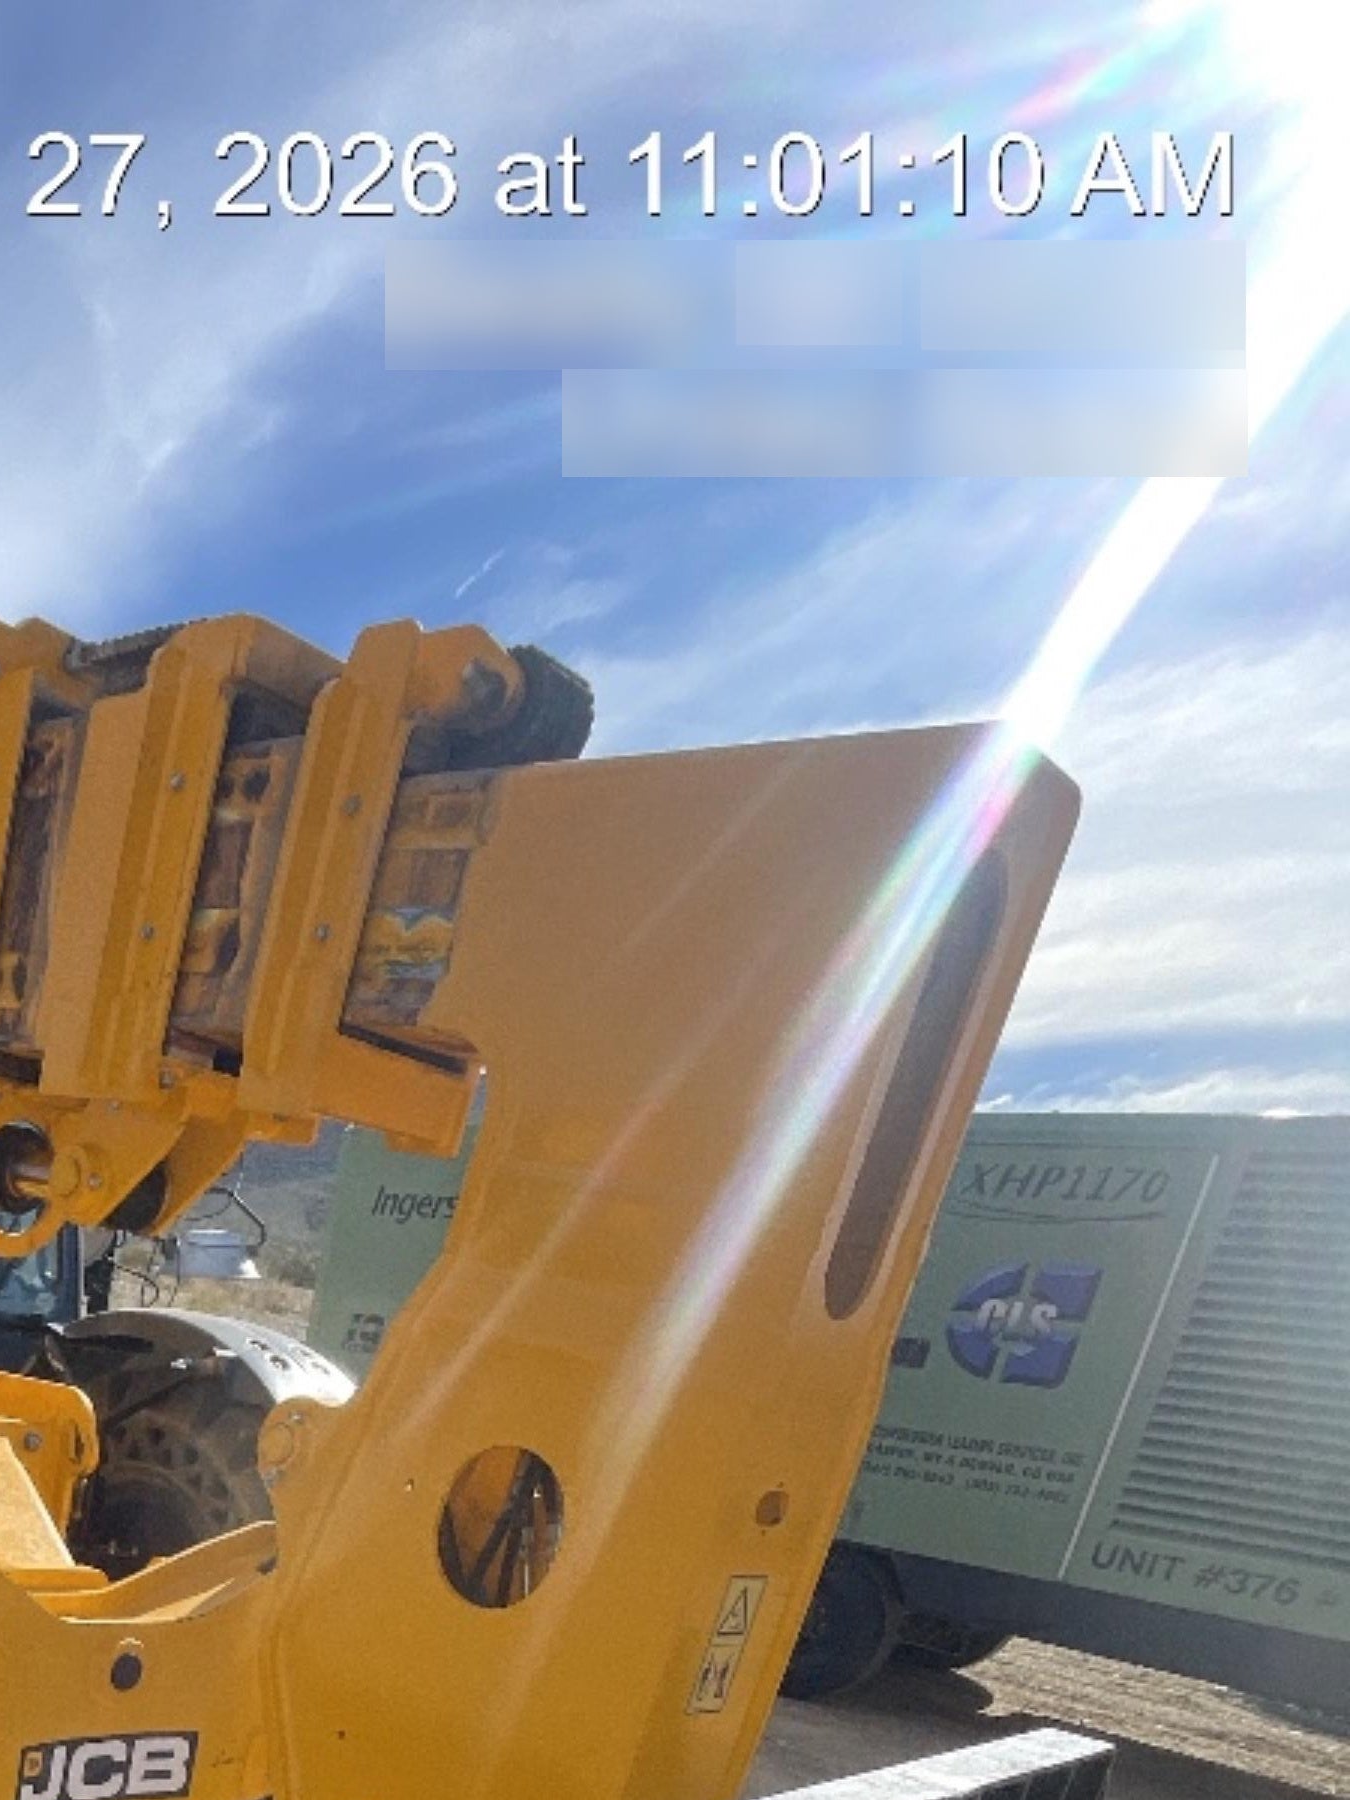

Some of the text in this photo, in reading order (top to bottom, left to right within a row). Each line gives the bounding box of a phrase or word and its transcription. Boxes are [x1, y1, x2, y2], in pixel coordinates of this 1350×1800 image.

[960, 1163, 1170, 1203] XHP1170
[1091, 1541, 1300, 1606] UNIT #376
